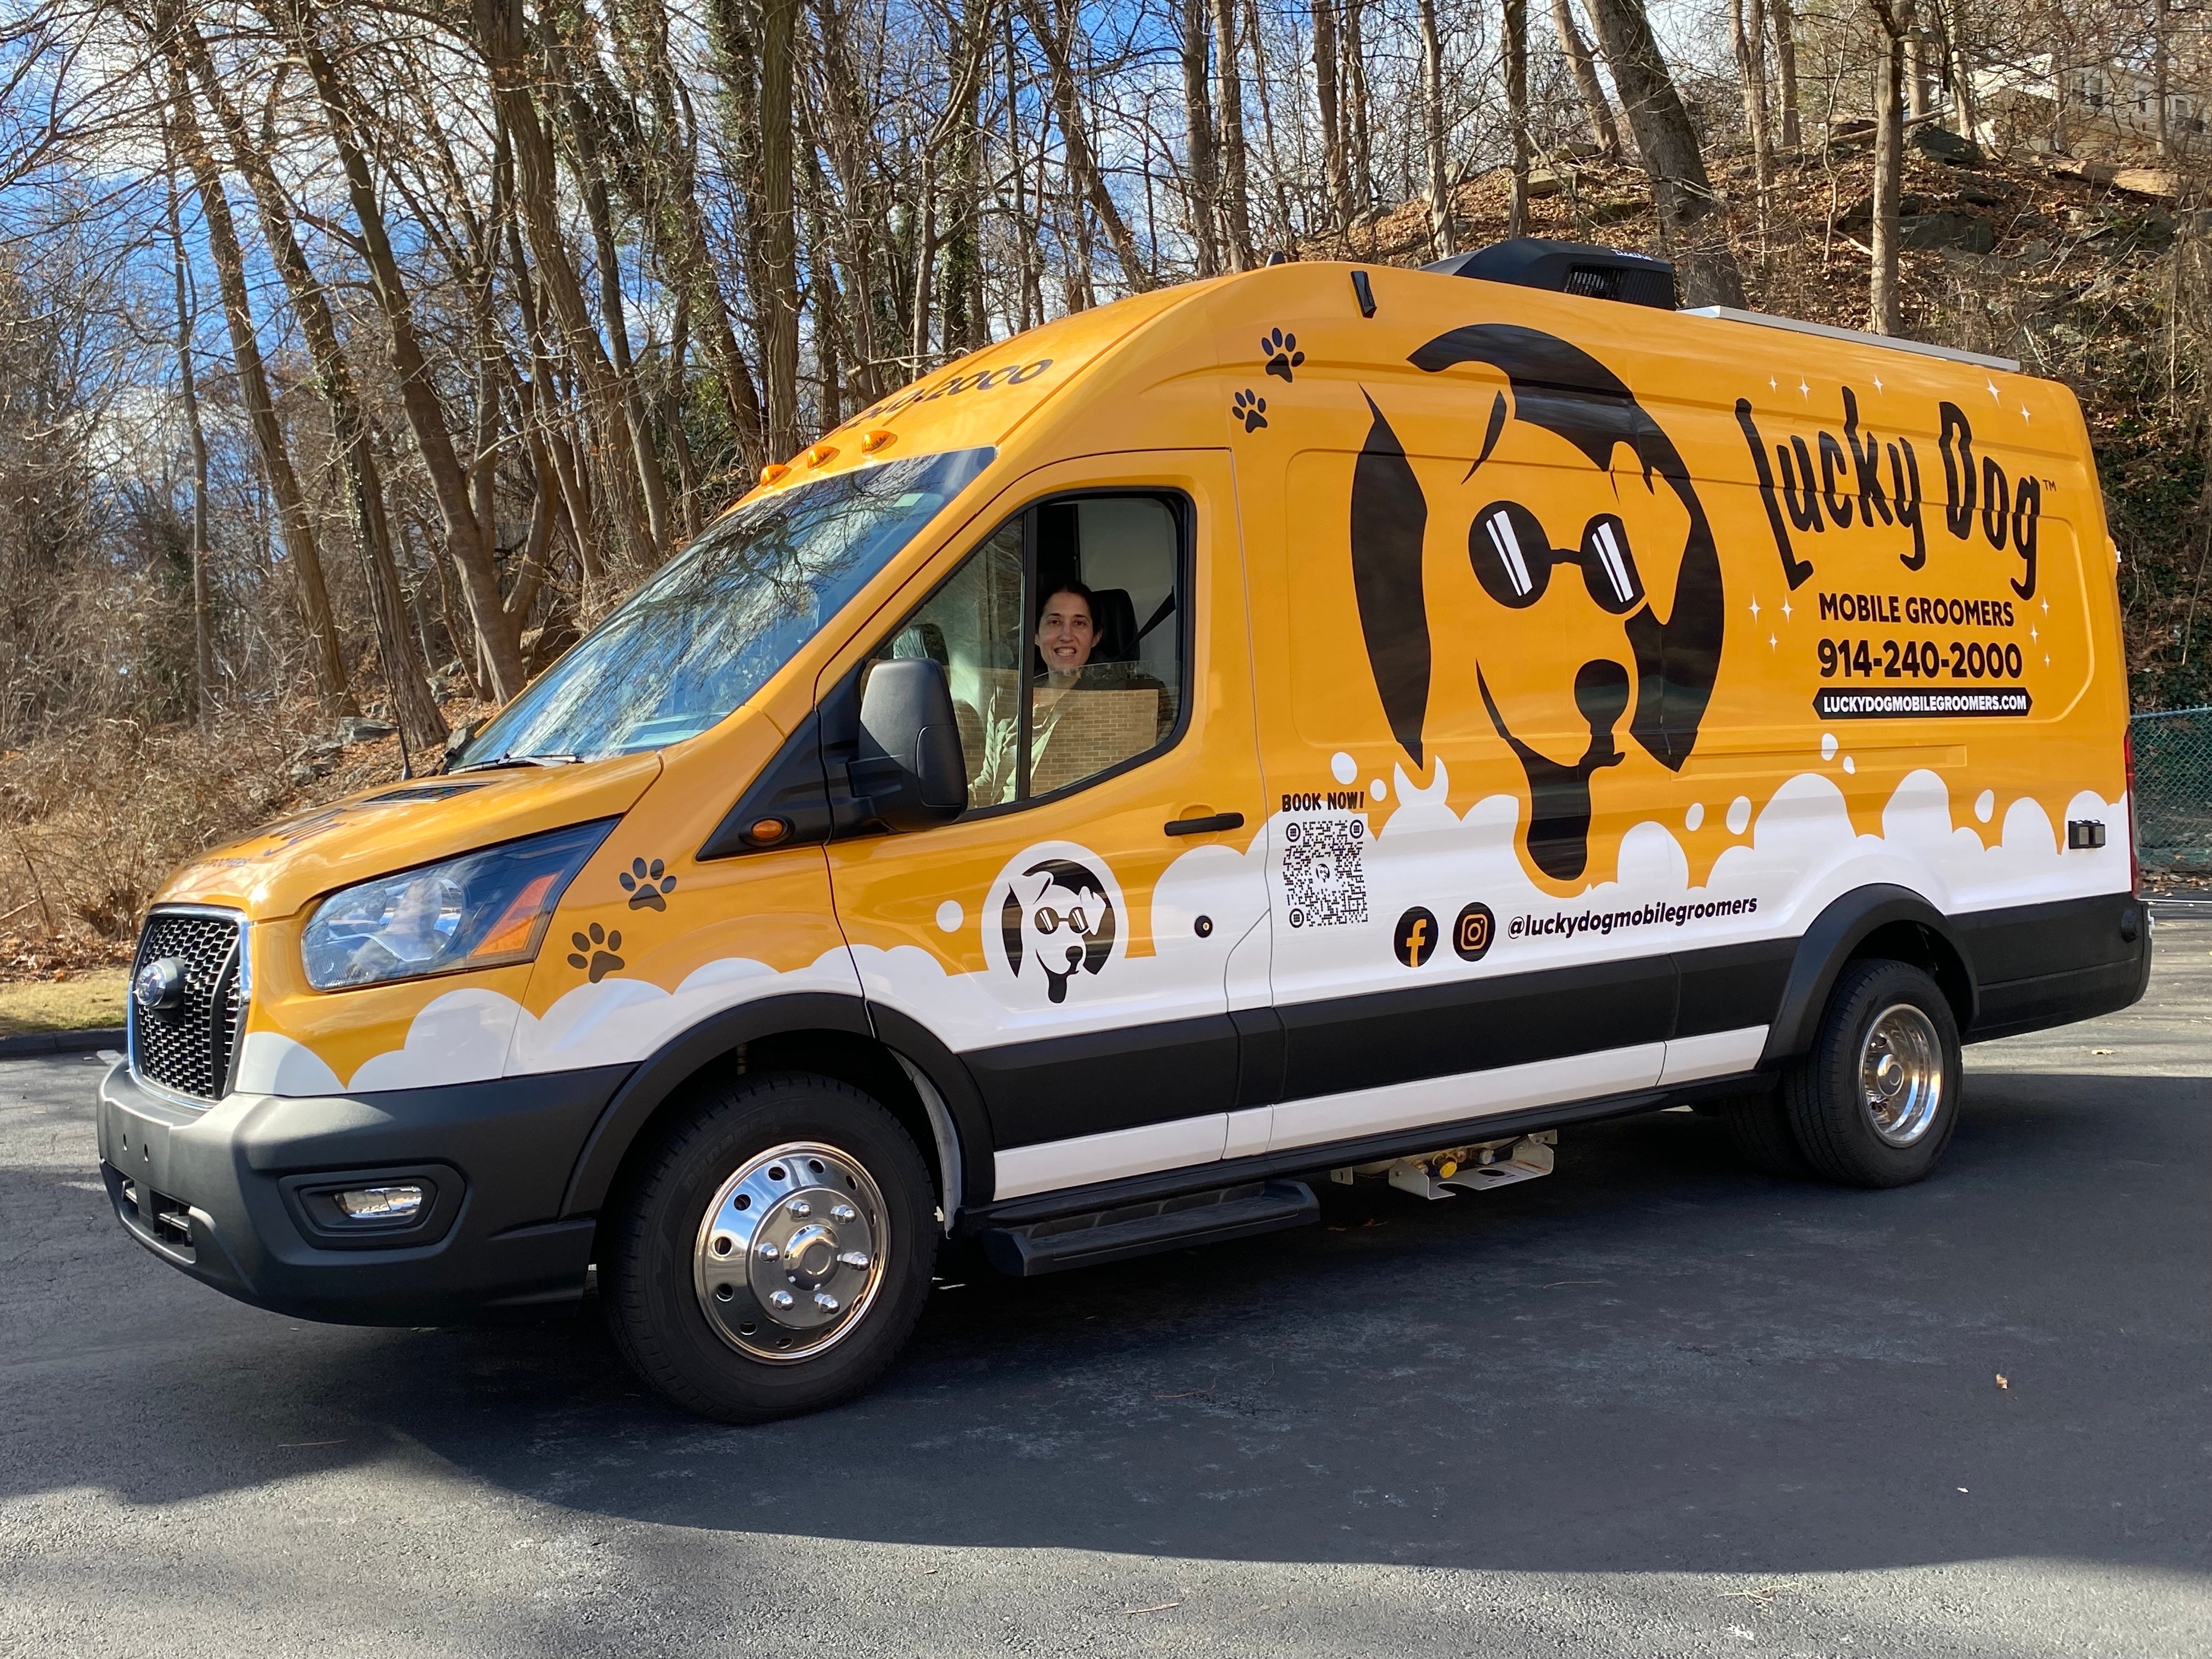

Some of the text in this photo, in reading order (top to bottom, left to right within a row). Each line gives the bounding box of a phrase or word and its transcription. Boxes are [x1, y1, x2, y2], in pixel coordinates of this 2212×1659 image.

[1735, 386, 1926, 591] Lucky
[1939, 401, 2041, 601] Dog
[1818, 592, 2015, 627] MOBILE GROOMERS
[1817, 638, 2023, 679] 914-240-2000
[1822, 694, 2027, 713] LUCKYDOGMOBILEGROOMERS.COM
[1282, 791, 1364, 812] BOOK NOW!
[1508, 898, 1758, 939] @luckydogmobilegroomers
